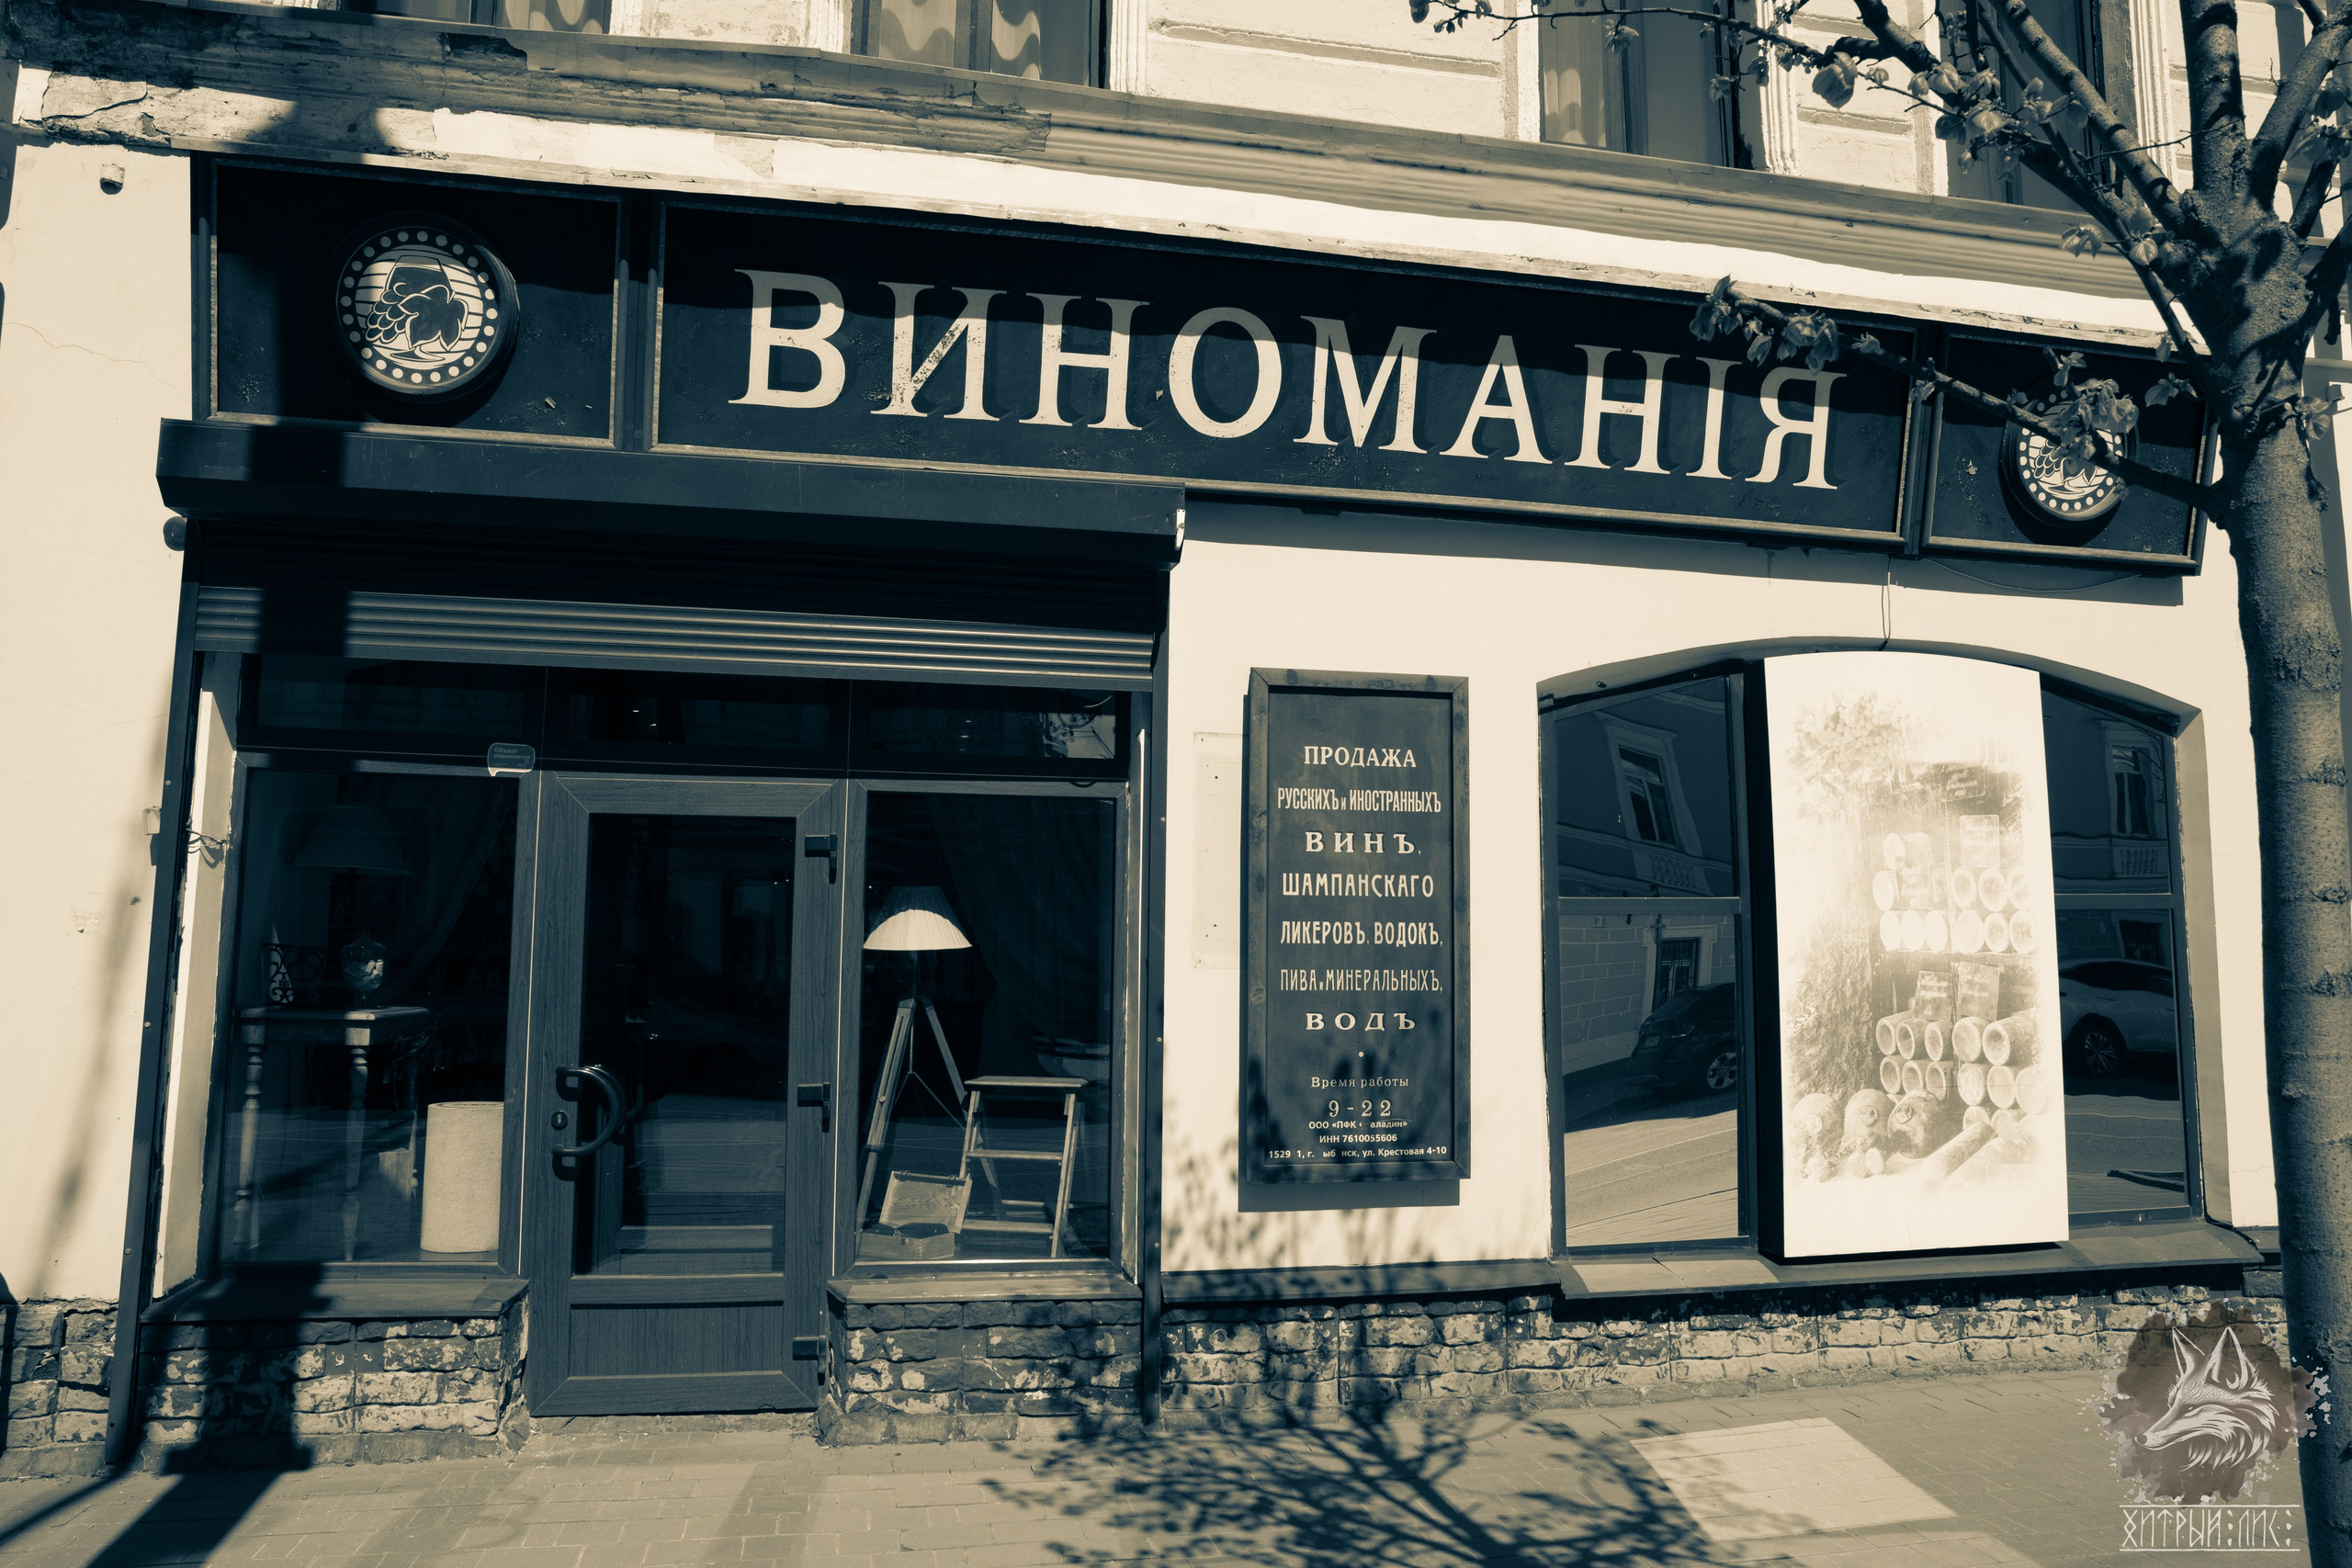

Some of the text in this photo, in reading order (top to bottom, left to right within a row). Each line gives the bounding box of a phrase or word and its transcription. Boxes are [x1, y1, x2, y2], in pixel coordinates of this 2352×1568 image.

[729, 269, 1847, 490] ВИНОМАНІЯ
[1304, 746, 1417, 768] ПРОДАЖА
[1277, 787, 1340, 811] РУССКИХЪ
[1349, 789, 1442, 813] ИНОСТРАННЫХЪ
[1283, 873, 1434, 897] ШАМПАНСКАГО
[1374, 921, 1443, 948] ВОДОКЪ,
[1280, 969, 1317, 991] ПИВА
[1325, 969, 1443, 993] МИНЕРАЛЬНЫХЪ,
[1306, 1012, 1416, 1032] ВОДЪ
[1310, 1077, 1409, 1089] Время работы
[1308, 1121, 1329, 1130] ООО
[1319, 1134, 1397, 1144] ИНН 7610055606
[1269, 1145, 1447, 1159] 15291, г. ыбнск, ул. Крестовая 4-10
